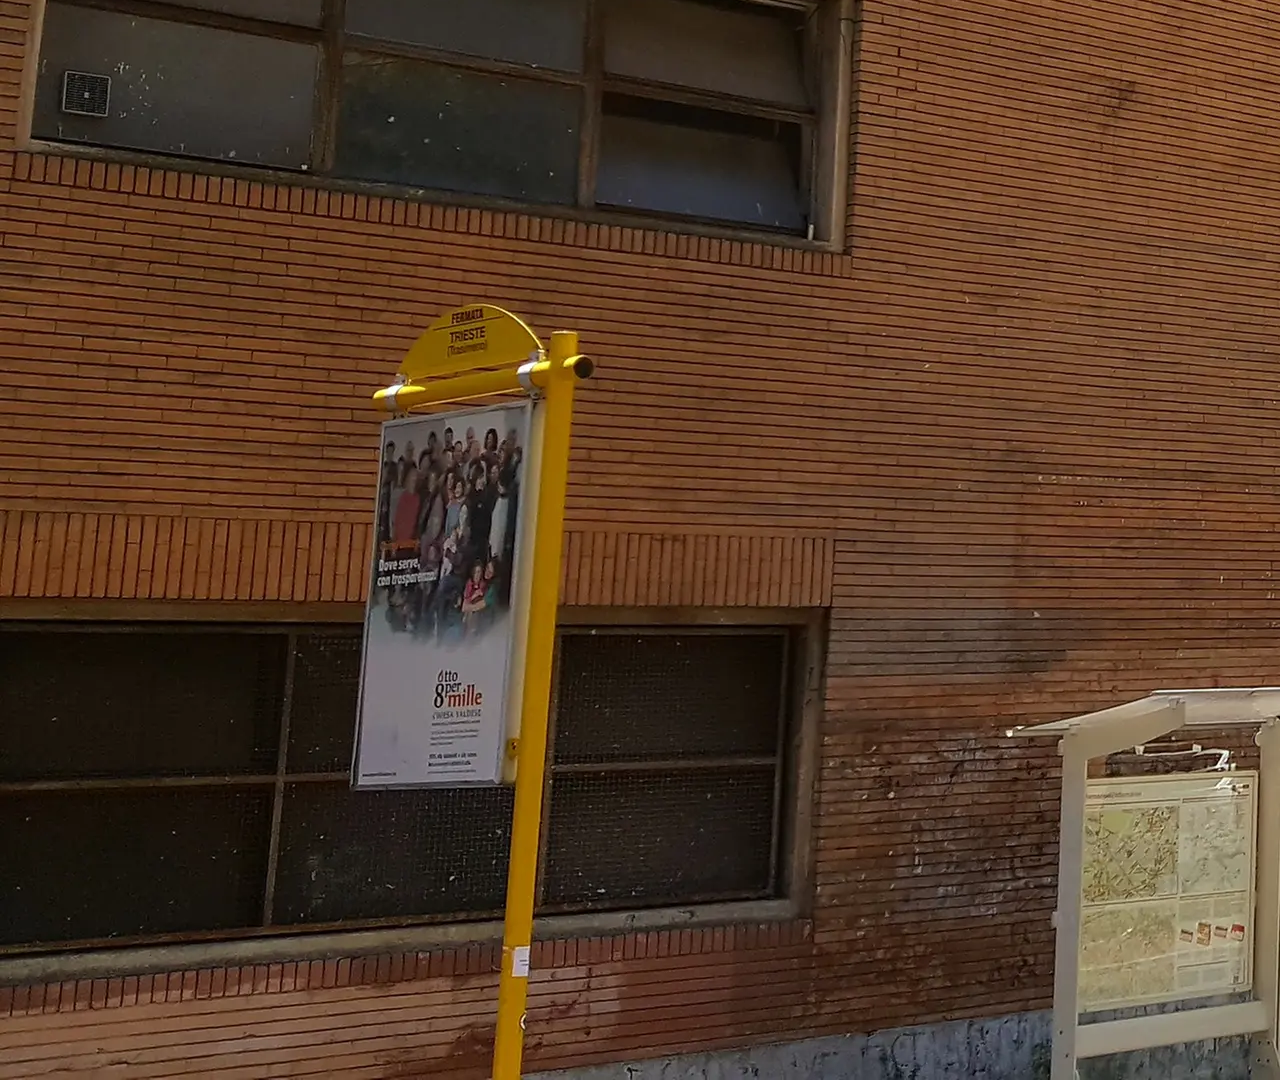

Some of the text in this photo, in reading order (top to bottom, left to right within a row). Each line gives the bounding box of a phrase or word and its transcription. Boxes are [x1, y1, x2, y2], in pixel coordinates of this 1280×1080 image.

[451, 308, 484, 325] FERMATA
[449, 325, 486, 343] TRIESTE
[378, 558, 421, 572] Dove serve,
[433, 682, 483, 709] 8 per mille
